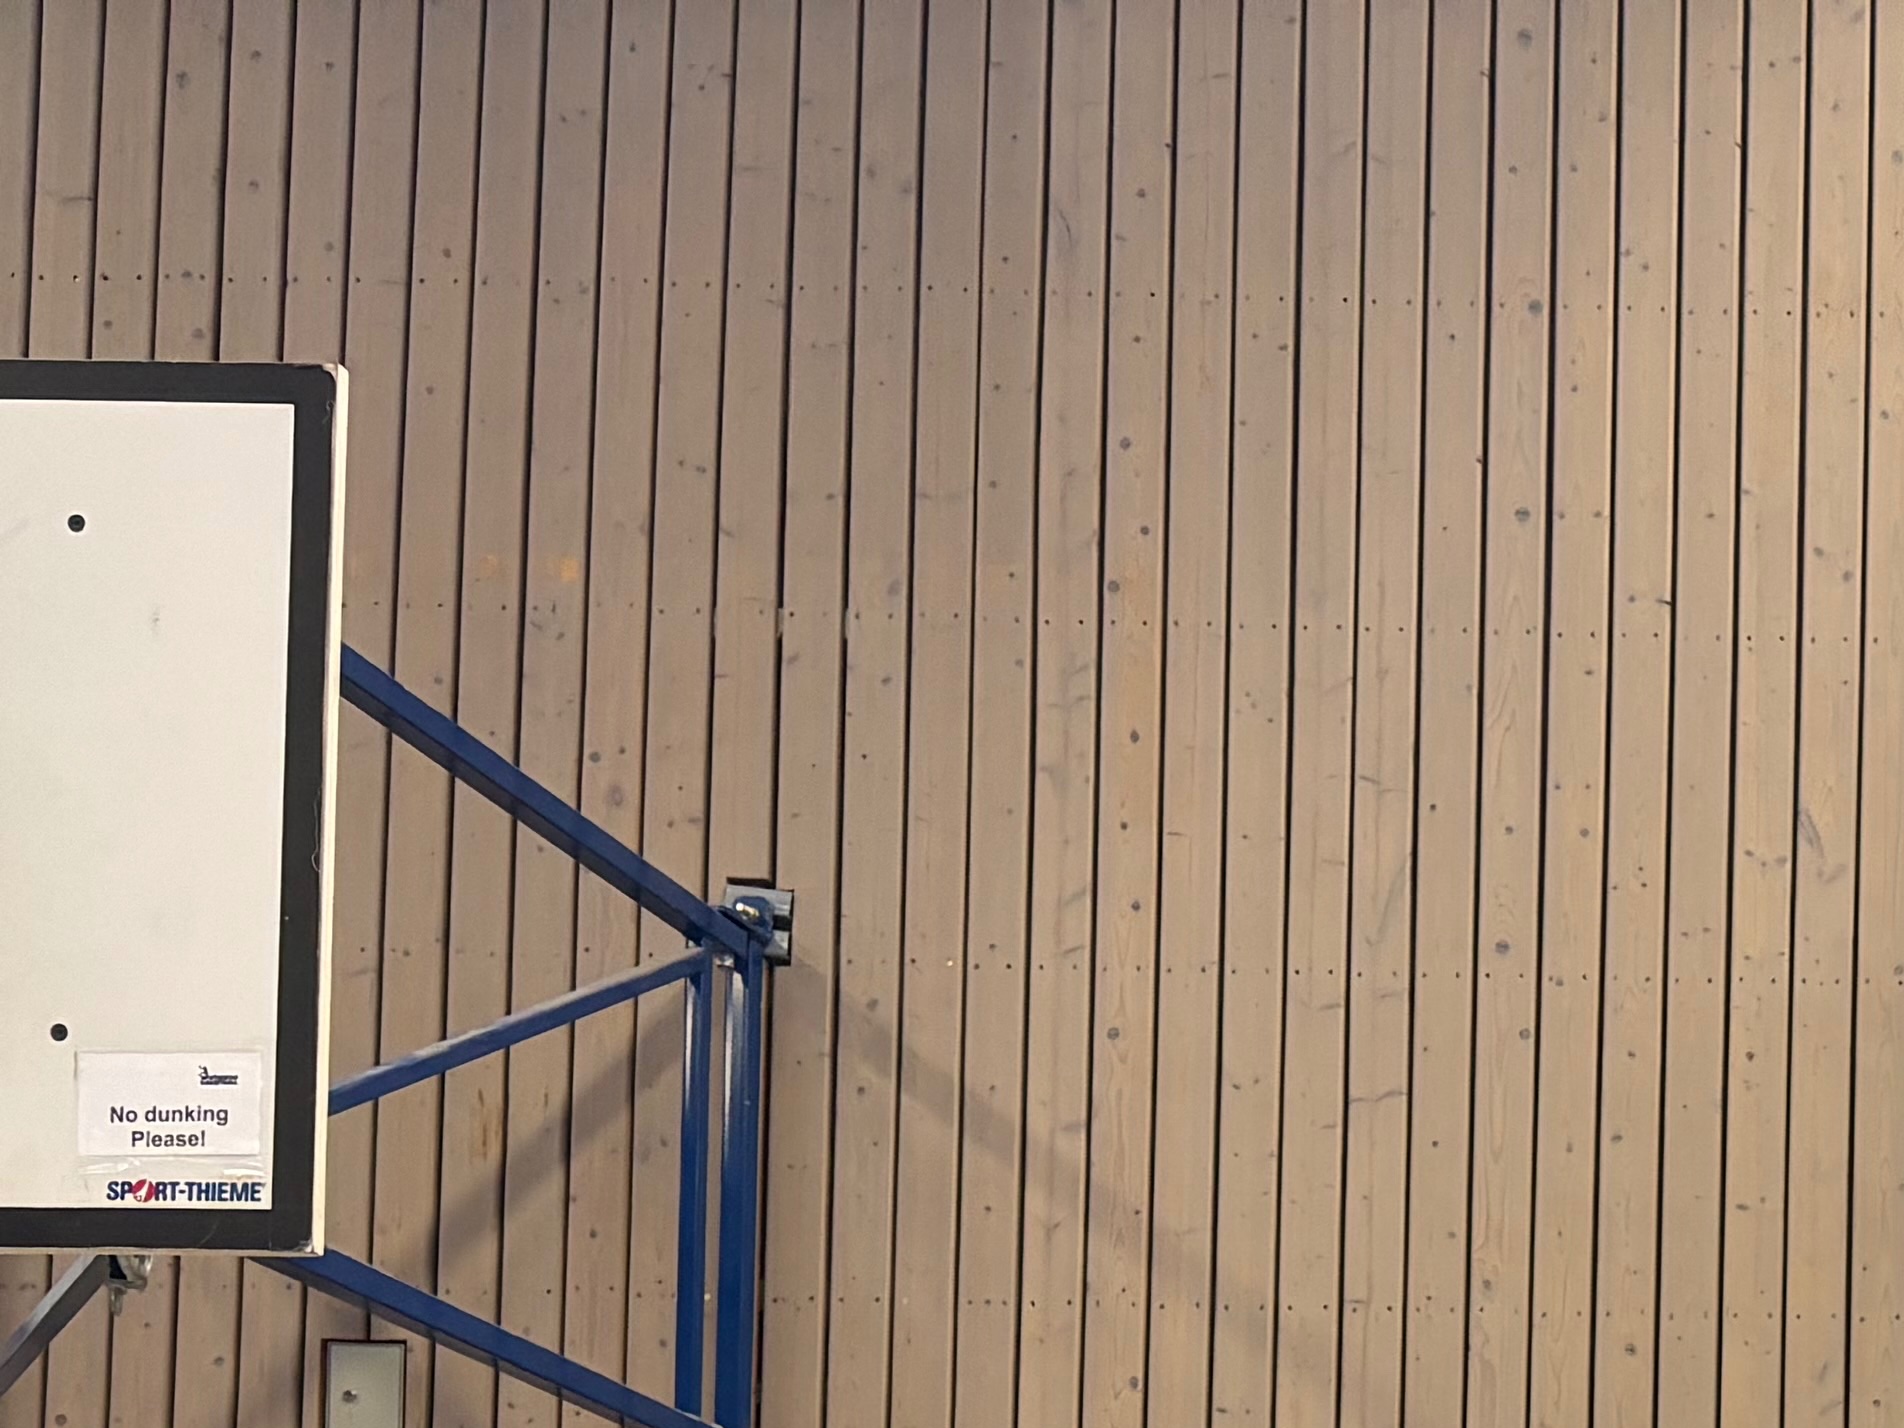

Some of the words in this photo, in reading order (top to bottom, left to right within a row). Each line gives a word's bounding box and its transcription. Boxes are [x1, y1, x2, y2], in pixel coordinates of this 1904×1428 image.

[109, 1105, 138, 1124] No
[144, 1105, 229, 1126] dunking
[131, 1129, 206, 1147] Please!
